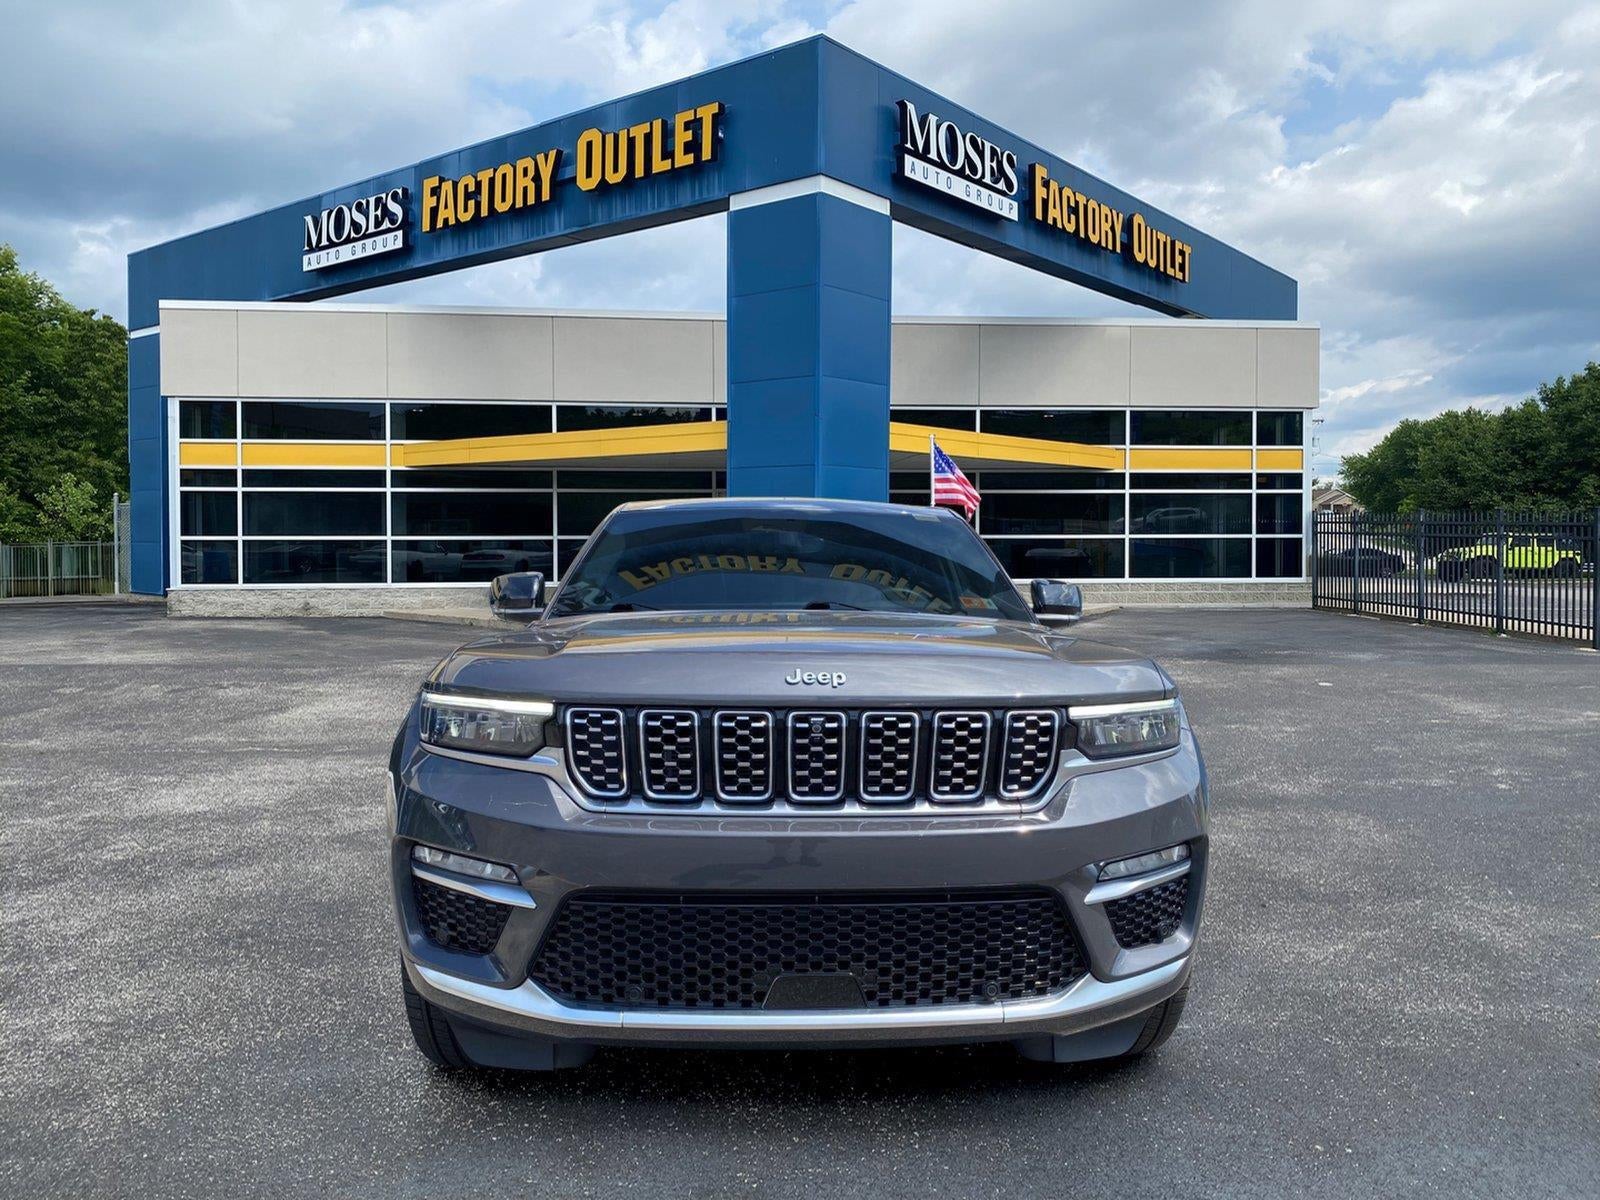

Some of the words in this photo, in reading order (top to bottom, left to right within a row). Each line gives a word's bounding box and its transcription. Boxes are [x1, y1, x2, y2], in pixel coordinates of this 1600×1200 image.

[422, 149, 558, 232] FACTORY
[576, 102, 720, 191] OUTLET
[904, 100, 1018, 196] MOSES
[303, 187, 404, 251] MOSES
[909, 161, 952, 190] AUTO
[965, 185, 1014, 214] GROUP
[307, 248, 341, 267] AUTO
[350, 235, 400, 256] GROUP
[1034, 163, 1123, 254] FACTORY
[1132, 213, 1192, 283] OUTLET
[785, 668, 846, 688] Jeep
